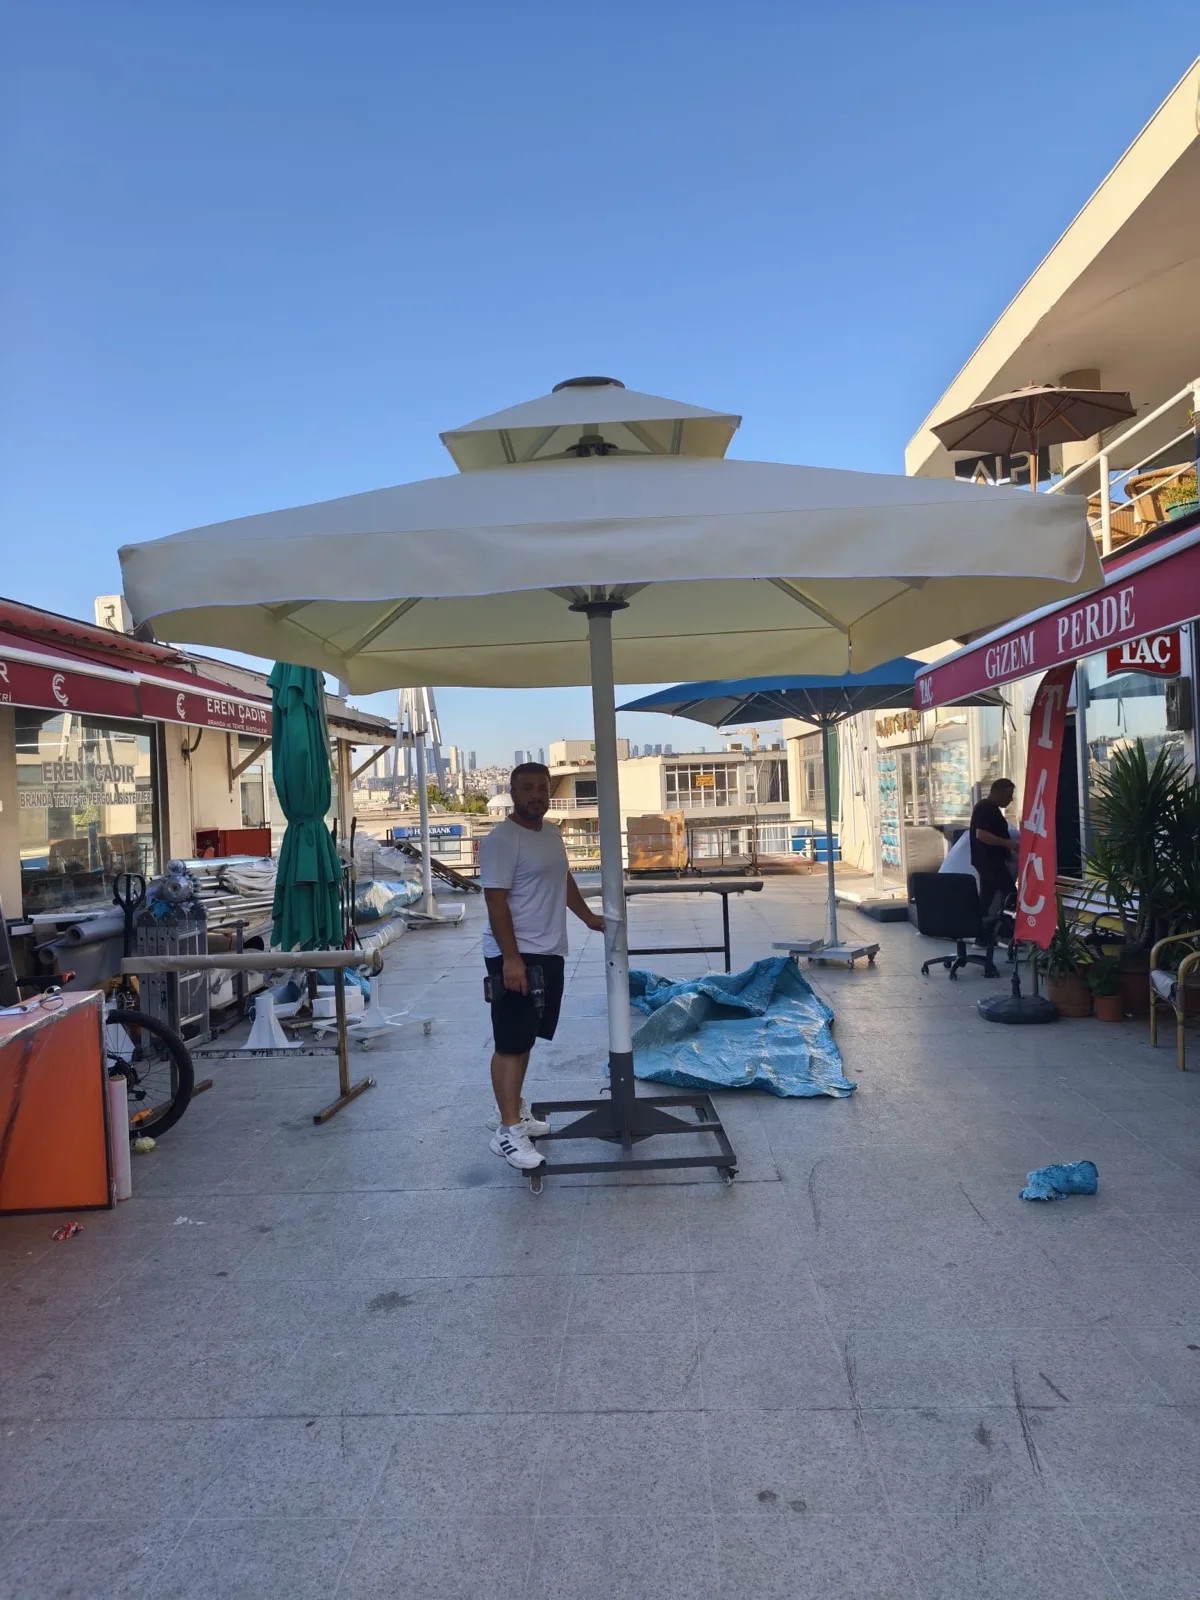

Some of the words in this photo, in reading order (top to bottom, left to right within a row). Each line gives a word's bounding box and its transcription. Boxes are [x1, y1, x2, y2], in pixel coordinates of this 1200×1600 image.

[1056, 586, 1135, 654] PERDE
[206, 698, 235, 717] EREN
[238, 705, 267, 724] ÇADIR
[41, 761, 84, 783] EREN
[94, 764, 136, 788] ÇADIR
[20, 791, 53, 808] BRANDA
[54, 791, 79, 808] TENTE
[88, 791, 120, 806] PERGOLA
